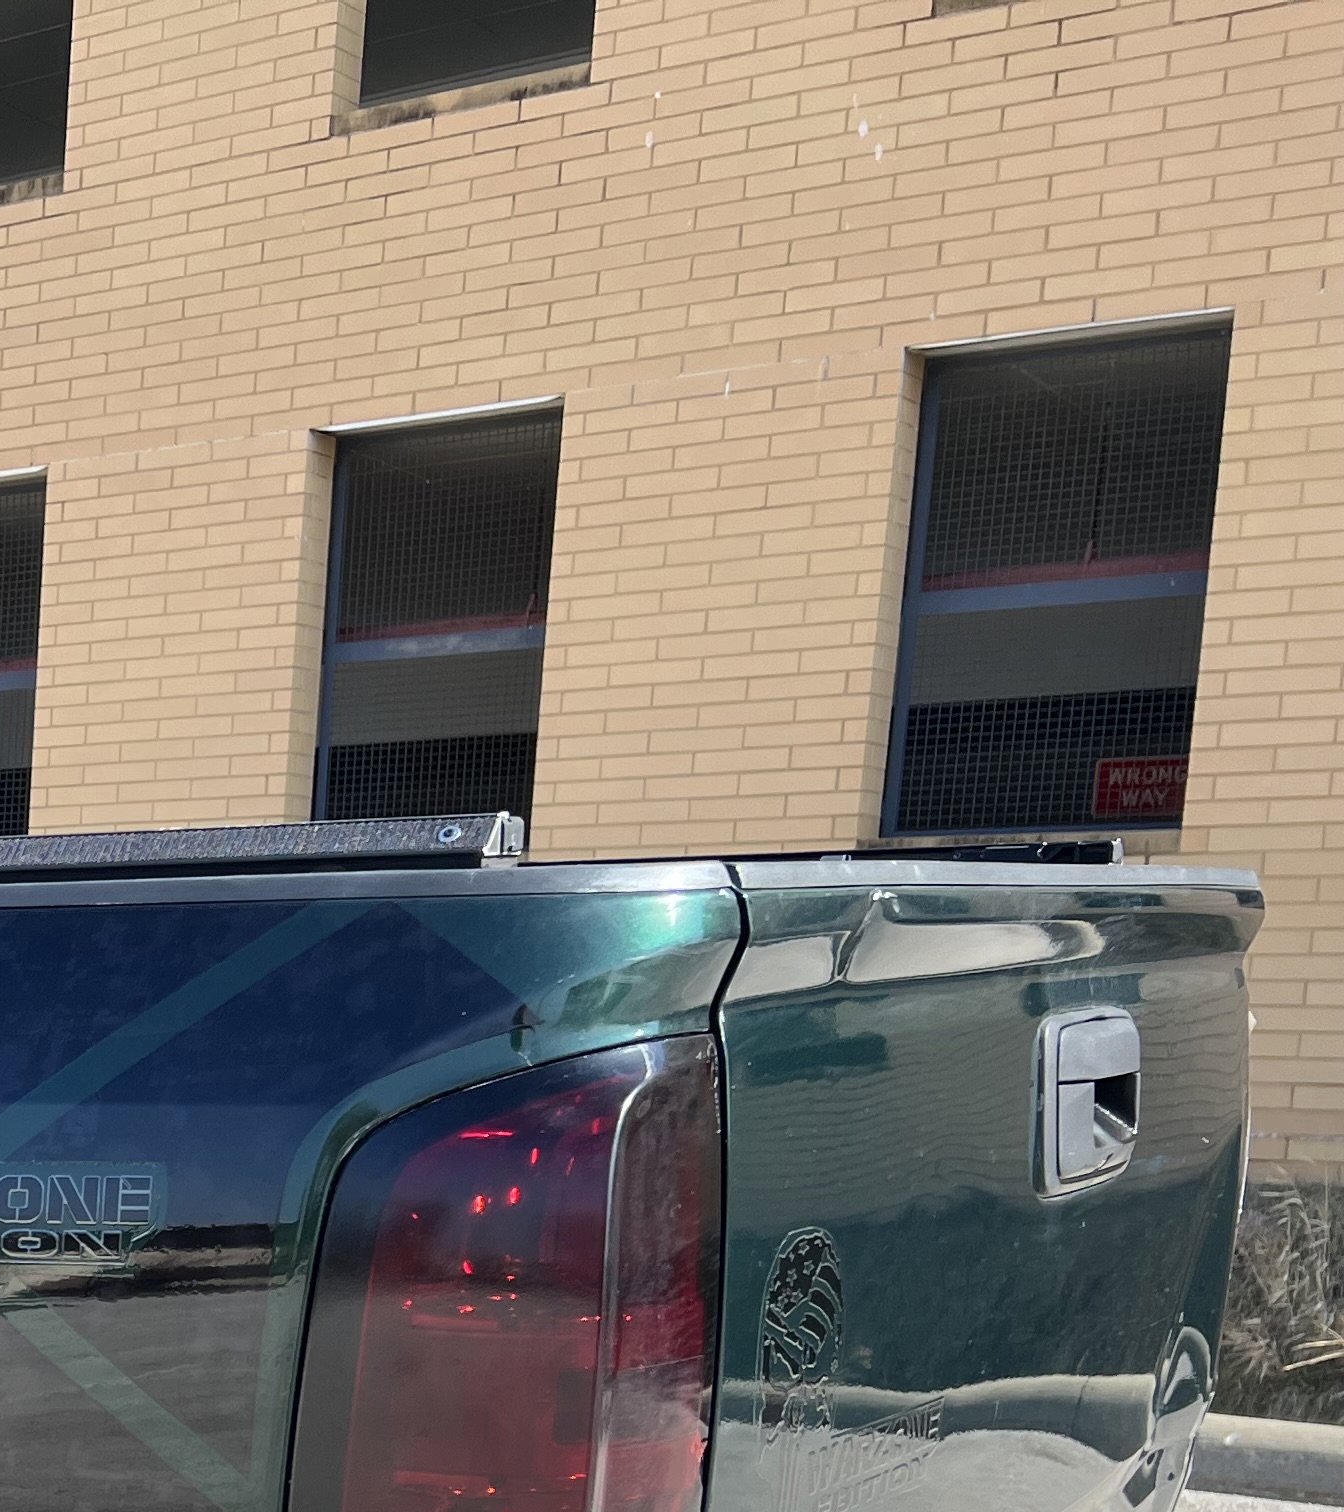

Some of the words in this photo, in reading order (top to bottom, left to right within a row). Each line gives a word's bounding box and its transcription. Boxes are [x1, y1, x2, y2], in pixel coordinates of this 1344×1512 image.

[1109, 765, 1188, 785] WRONG
[1123, 788, 1169, 807] WAY
[808, 1401, 941, 1496] WARZONE
